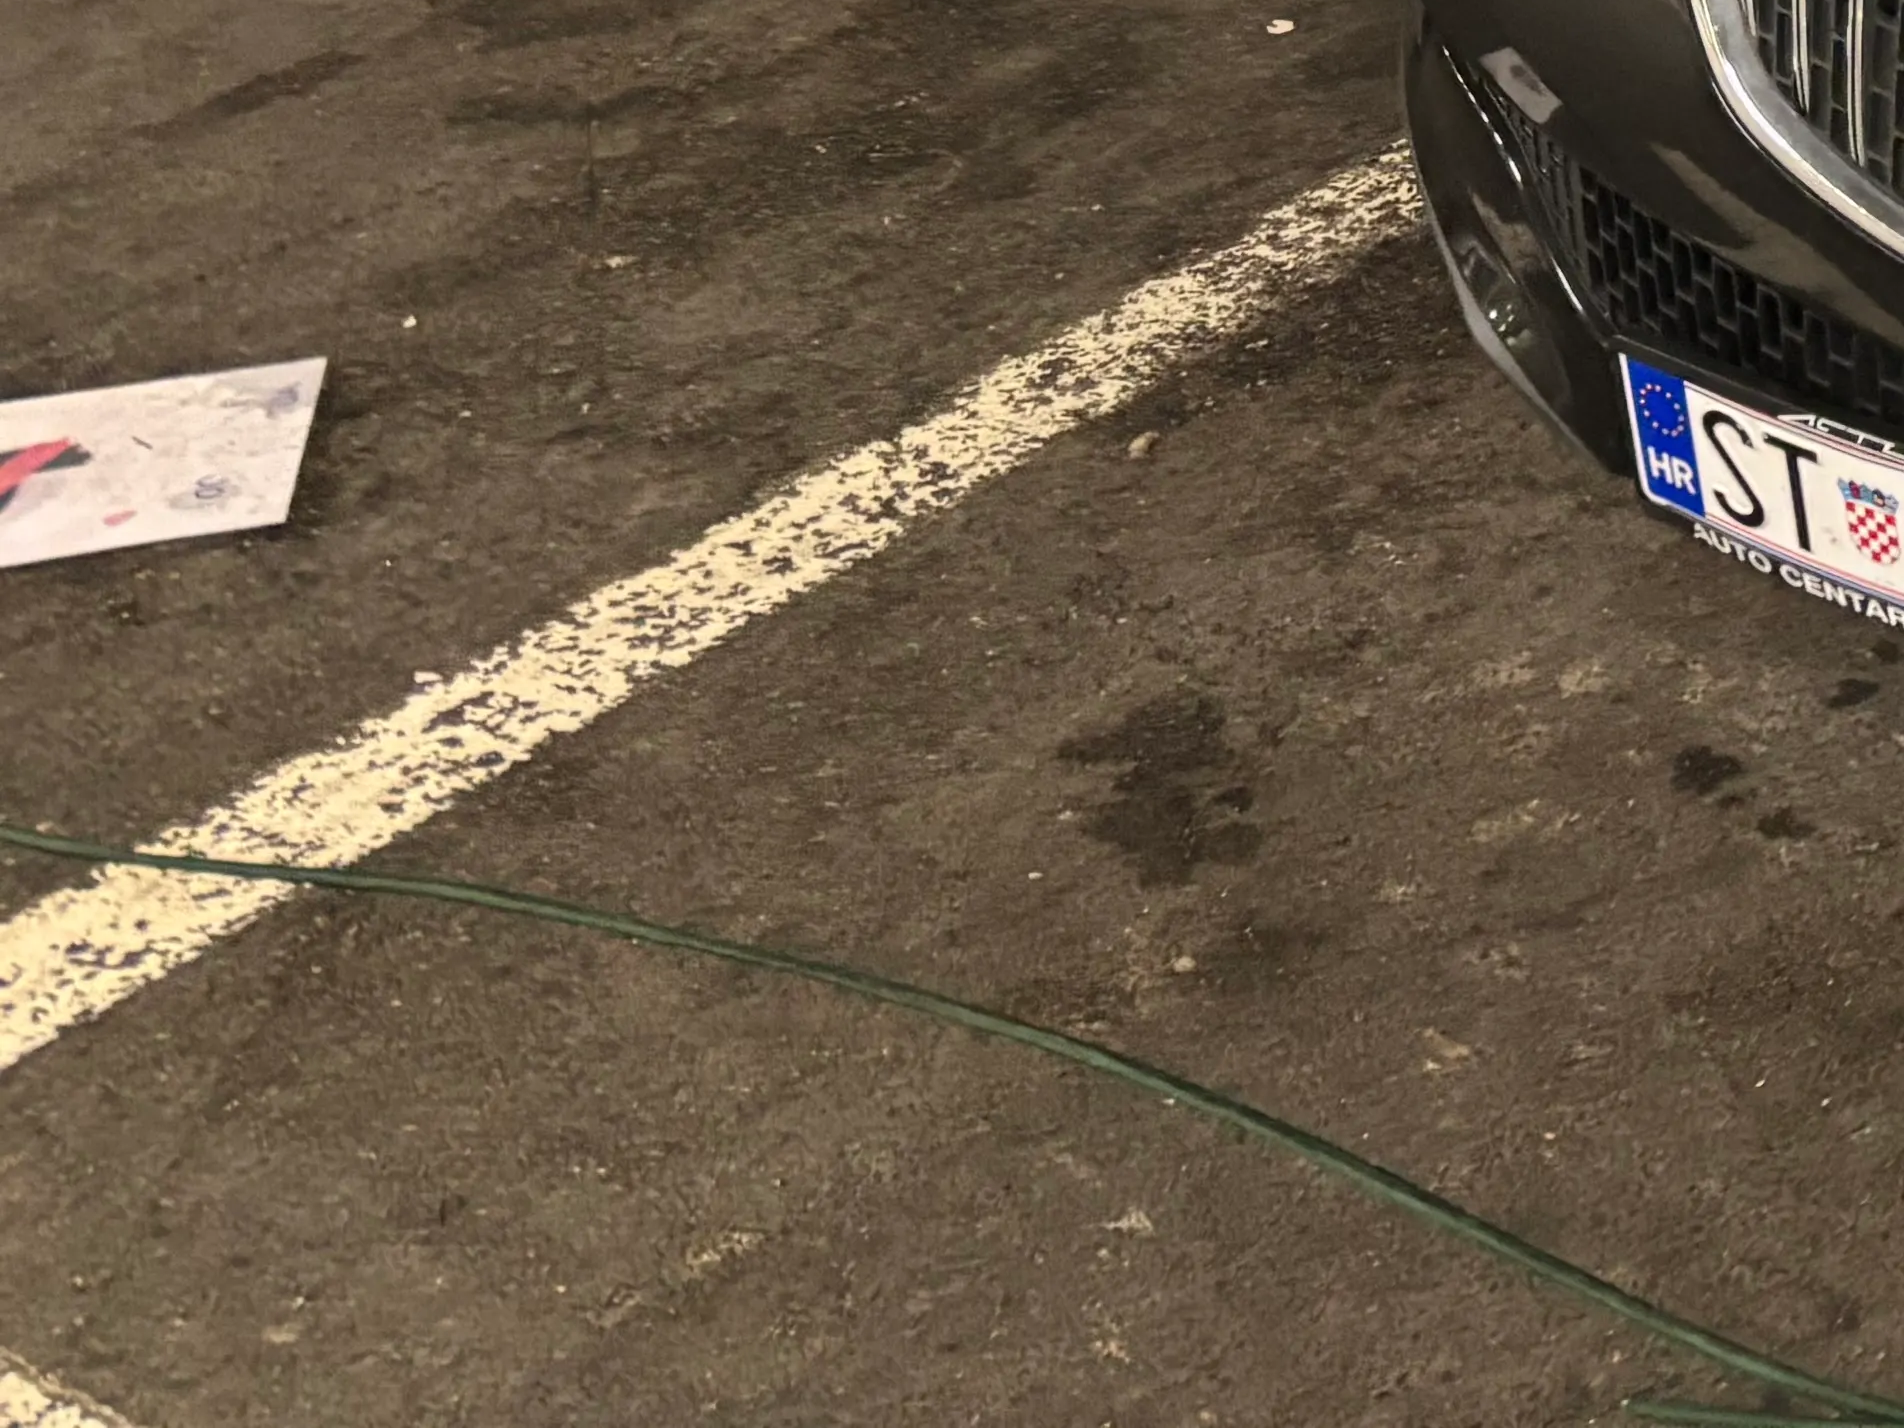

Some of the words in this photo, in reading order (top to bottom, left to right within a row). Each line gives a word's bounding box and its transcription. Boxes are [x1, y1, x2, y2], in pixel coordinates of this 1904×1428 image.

[1648, 446, 1697, 495] HR
[1702, 409, 1819, 552] ST
[1692, 522, 1773, 574] AUTO
